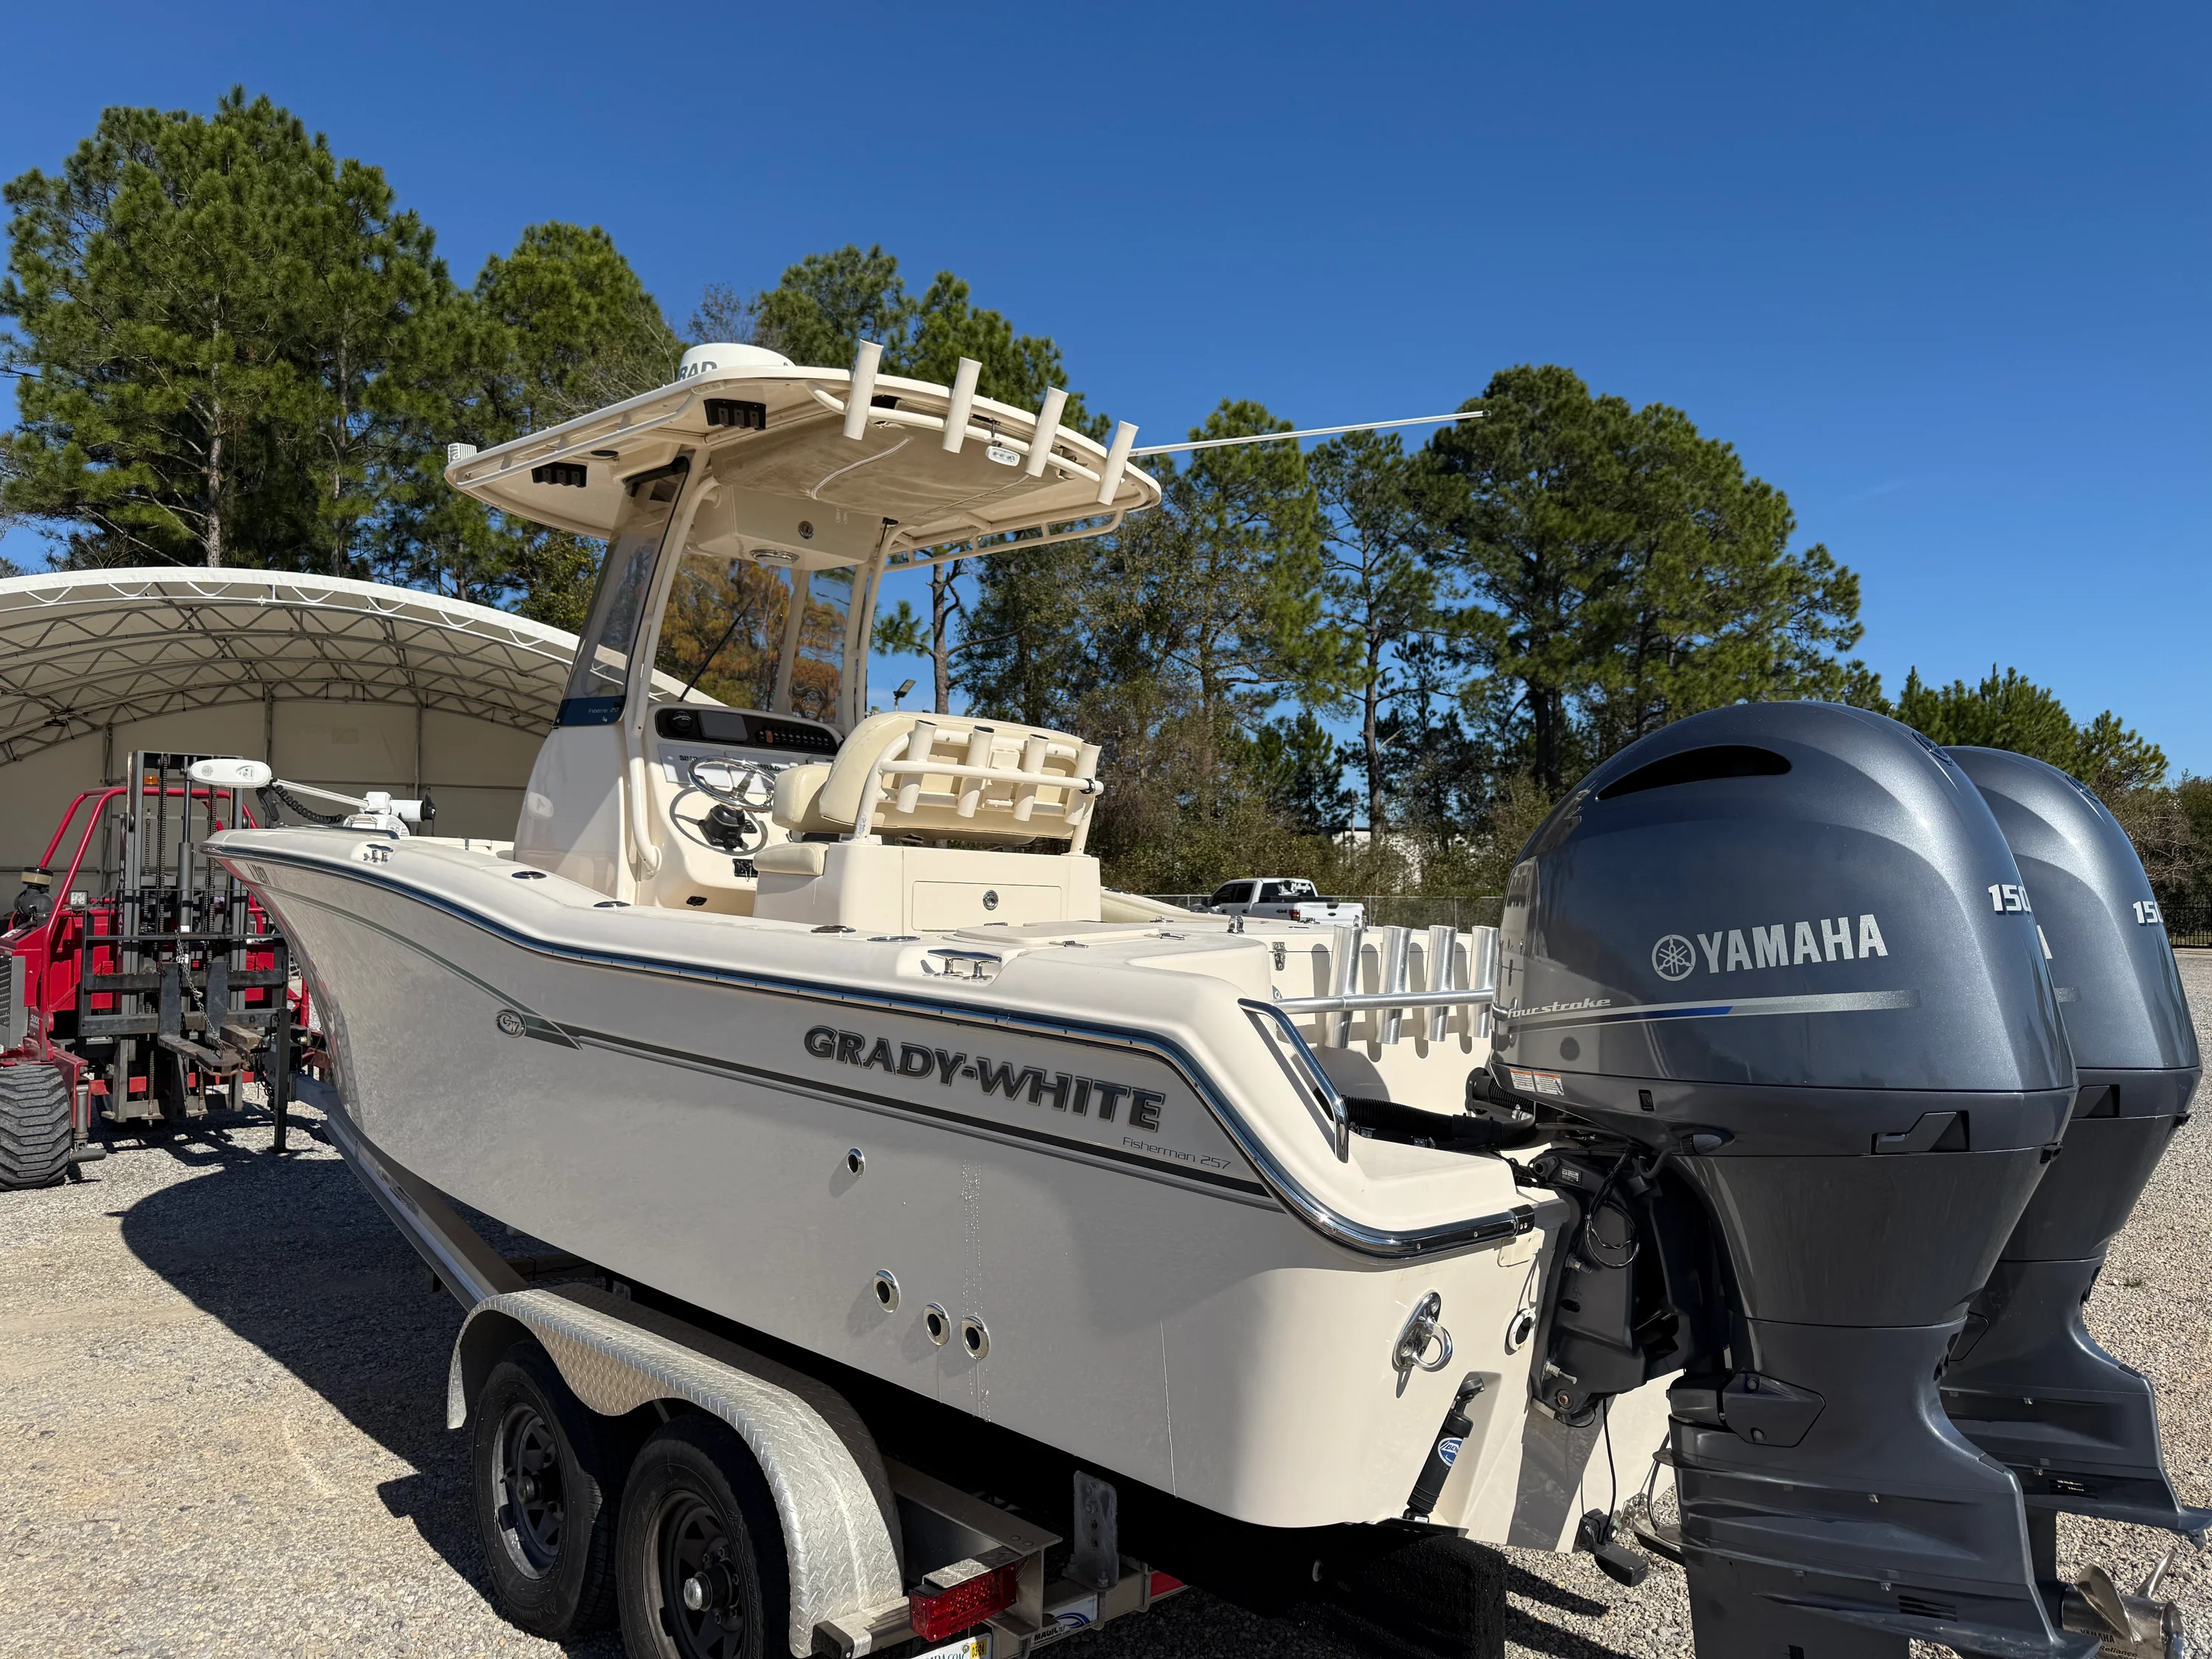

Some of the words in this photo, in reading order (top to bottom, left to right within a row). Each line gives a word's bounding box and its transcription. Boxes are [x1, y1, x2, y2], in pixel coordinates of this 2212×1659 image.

[1696, 914, 1888, 974] YAMAHA
[804, 1026, 1166, 1133] GRADY-WHITE
[1122, 1136, 1196, 1163] Fisherman
[1200, 1155, 1232, 1169] 257
[2100, 1645, 2138, 1658] Reliance
